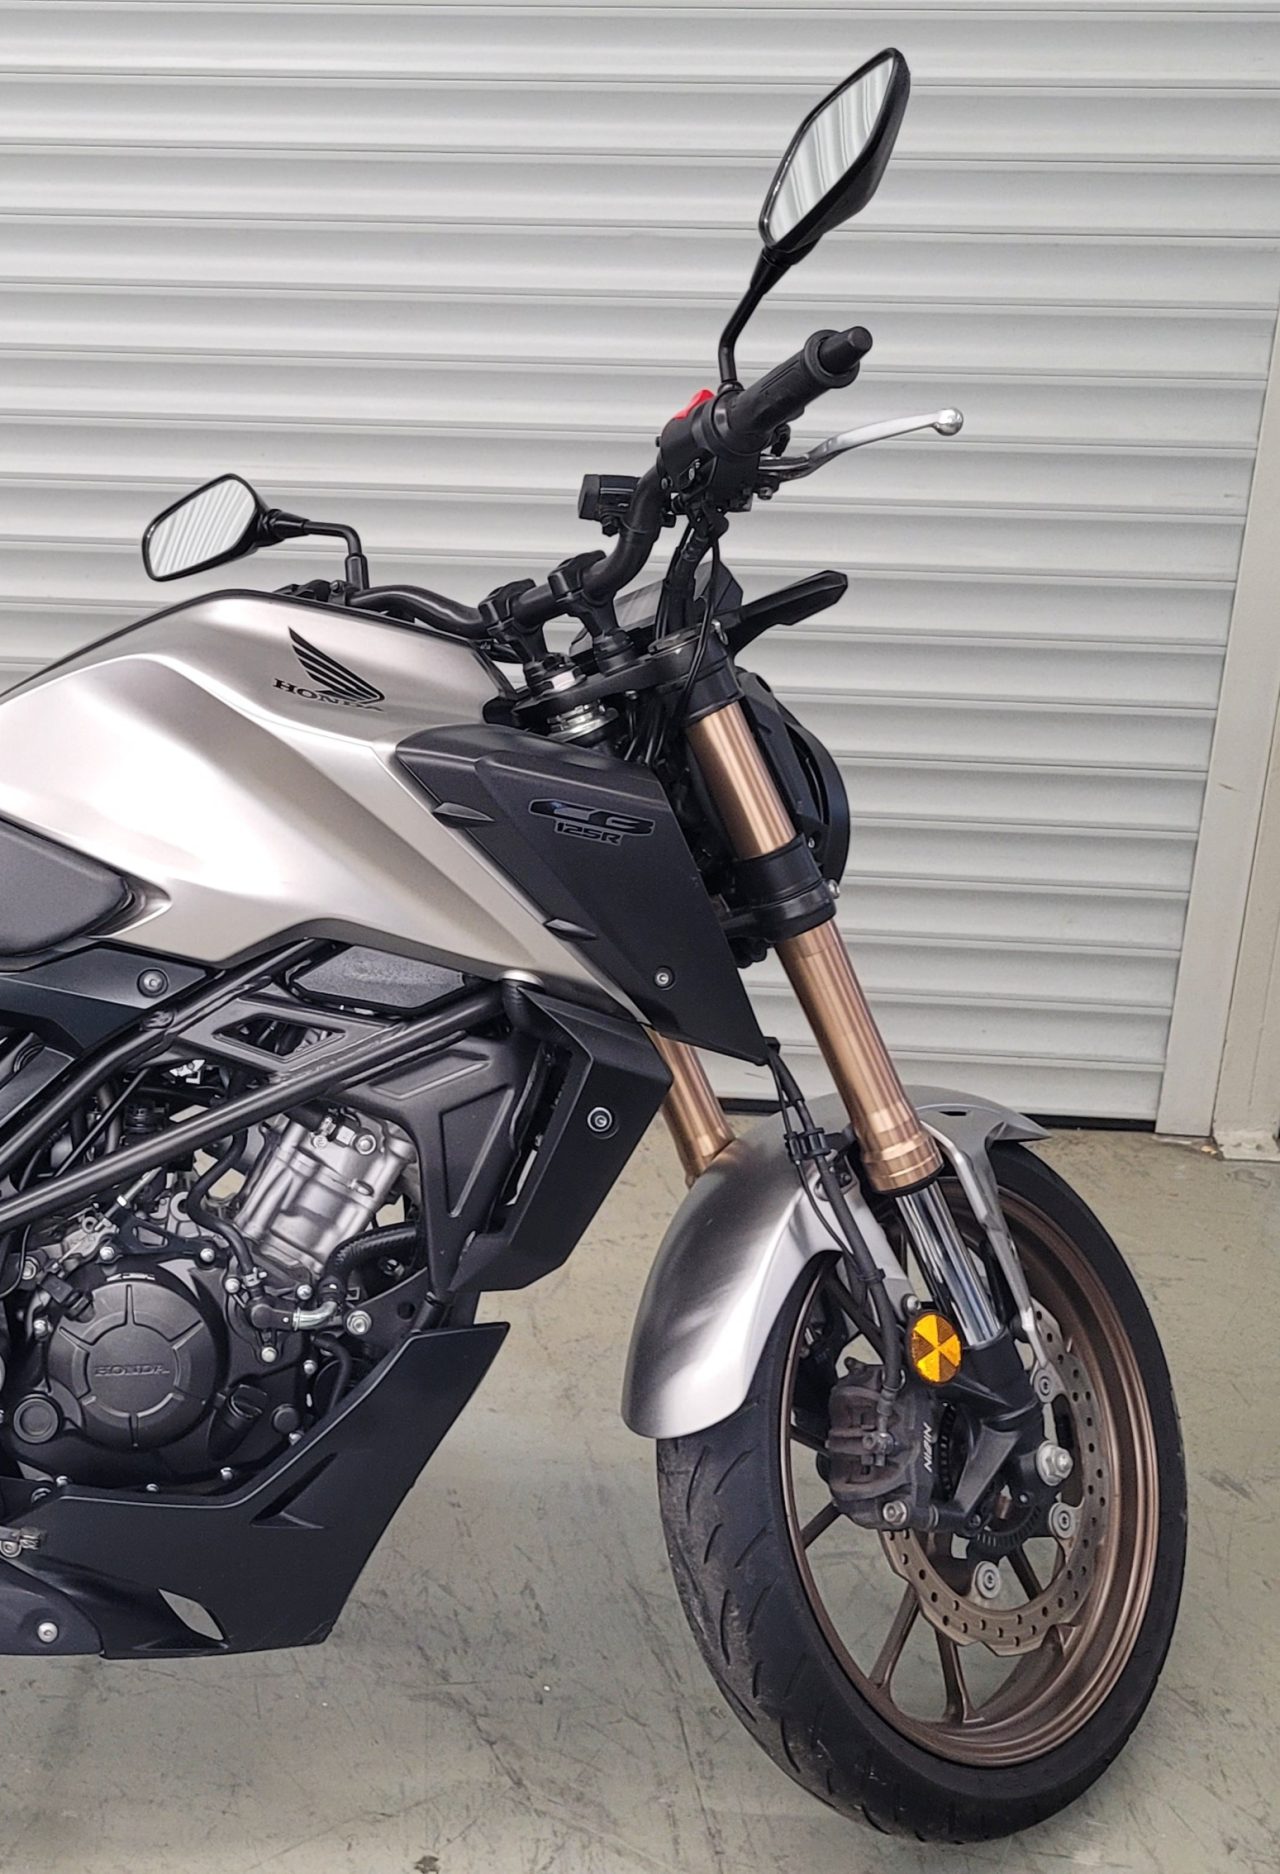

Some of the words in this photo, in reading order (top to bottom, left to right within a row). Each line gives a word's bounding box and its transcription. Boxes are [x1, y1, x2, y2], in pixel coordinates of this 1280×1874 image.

[529, 799, 655, 836] CB
[555, 820, 623, 846] 125R
[93, 1363, 171, 1377] HONDA
